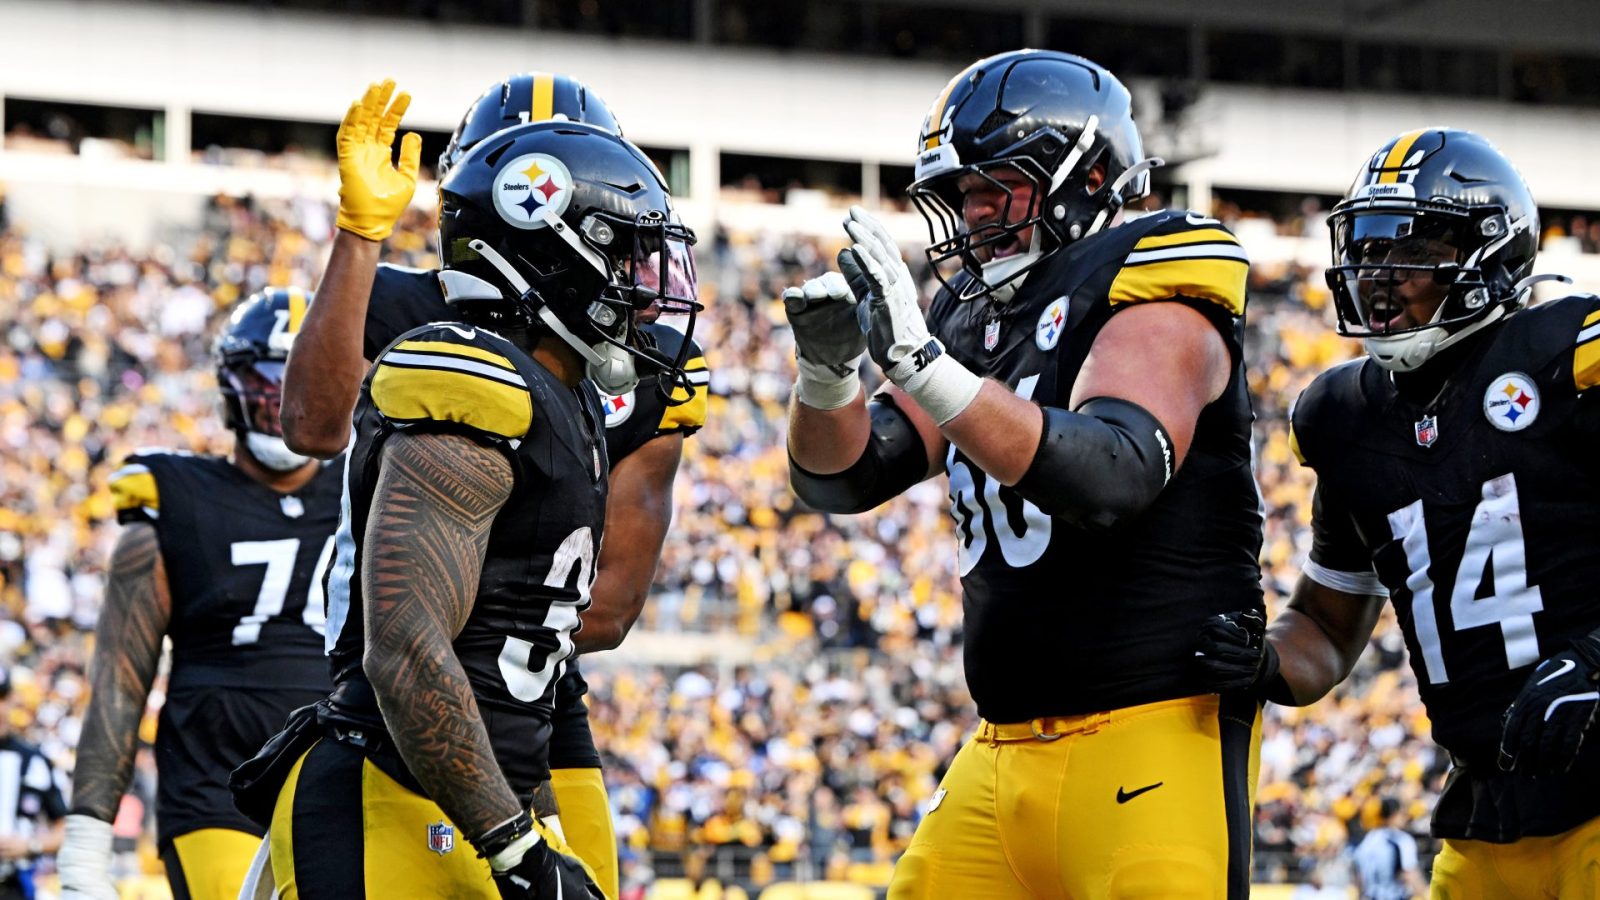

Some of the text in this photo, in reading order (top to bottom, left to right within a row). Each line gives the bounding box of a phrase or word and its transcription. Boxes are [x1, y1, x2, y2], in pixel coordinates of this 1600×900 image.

[1369, 149, 1426, 185] 14
[503, 182, 530, 191] Steelers
[1368, 185, 1399, 195] Steelers
[1489, 399, 1511, 408] Steelers
[1418, 427, 1436, 443] NFL
[1387, 472, 1544, 685] 14
[432, 835, 451, 848] NFL
